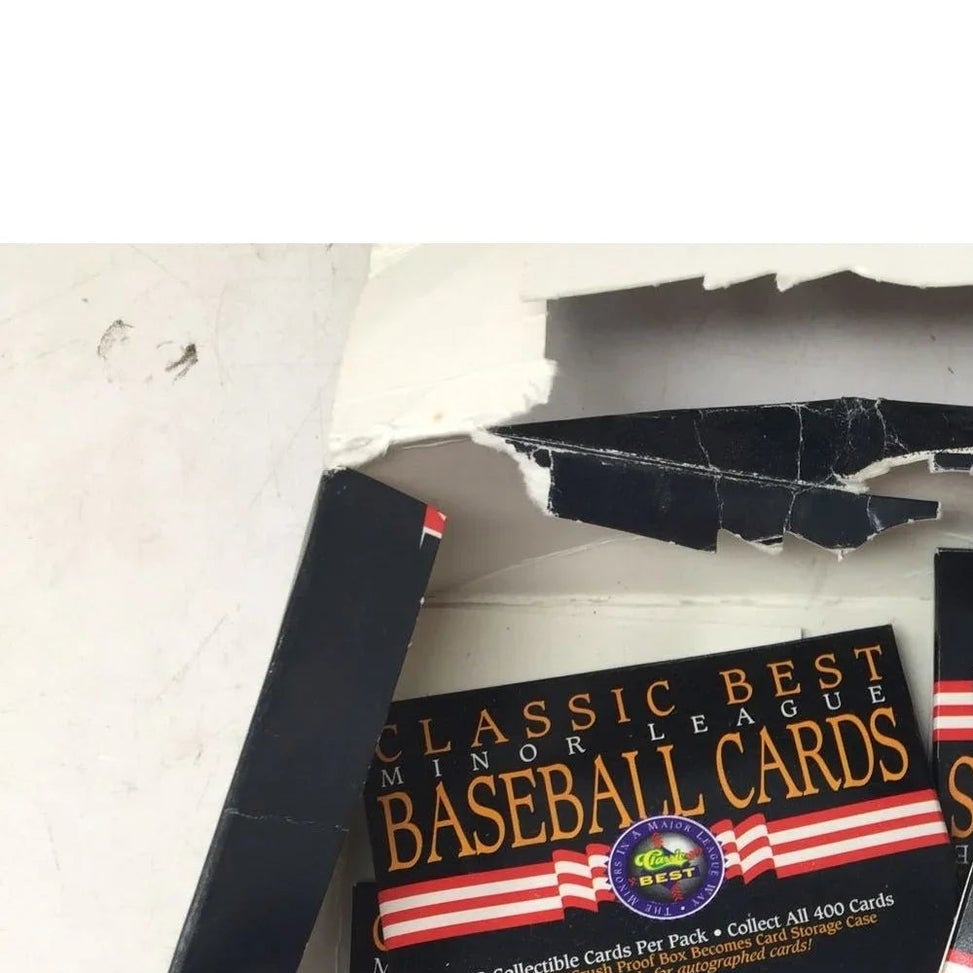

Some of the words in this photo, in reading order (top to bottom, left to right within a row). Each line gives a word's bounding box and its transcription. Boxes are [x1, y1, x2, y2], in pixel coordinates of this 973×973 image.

[375, 679, 676, 763] CLASSIC
[719, 644, 882, 705] BEST
[381, 735, 587, 788] MINOR
[647, 684, 886, 742] LEAGUE
[377, 743, 706, 873] BASEBALL
[715, 706, 909, 809] CARDS
[639, 867, 695, 887] BEST
[584, 943, 632, 967] Cards
[636, 938, 664, 955] Per
[668, 928, 709, 950] Pack
[727, 915, 781, 938] Collect
[785, 908, 810, 927] All
[813, 902, 845, 920] 400
[849, 892, 895, 913] Cards
[617, 954, 656, 973] Proof
[660, 950, 686, 966] Box
[691, 937, 752, 959] Becomes
[755, 929, 788, 946] Card
[792, 919, 843, 938] Storage
[846, 912, 879, 928] Case
[769, 938, 813, 957] cards!
